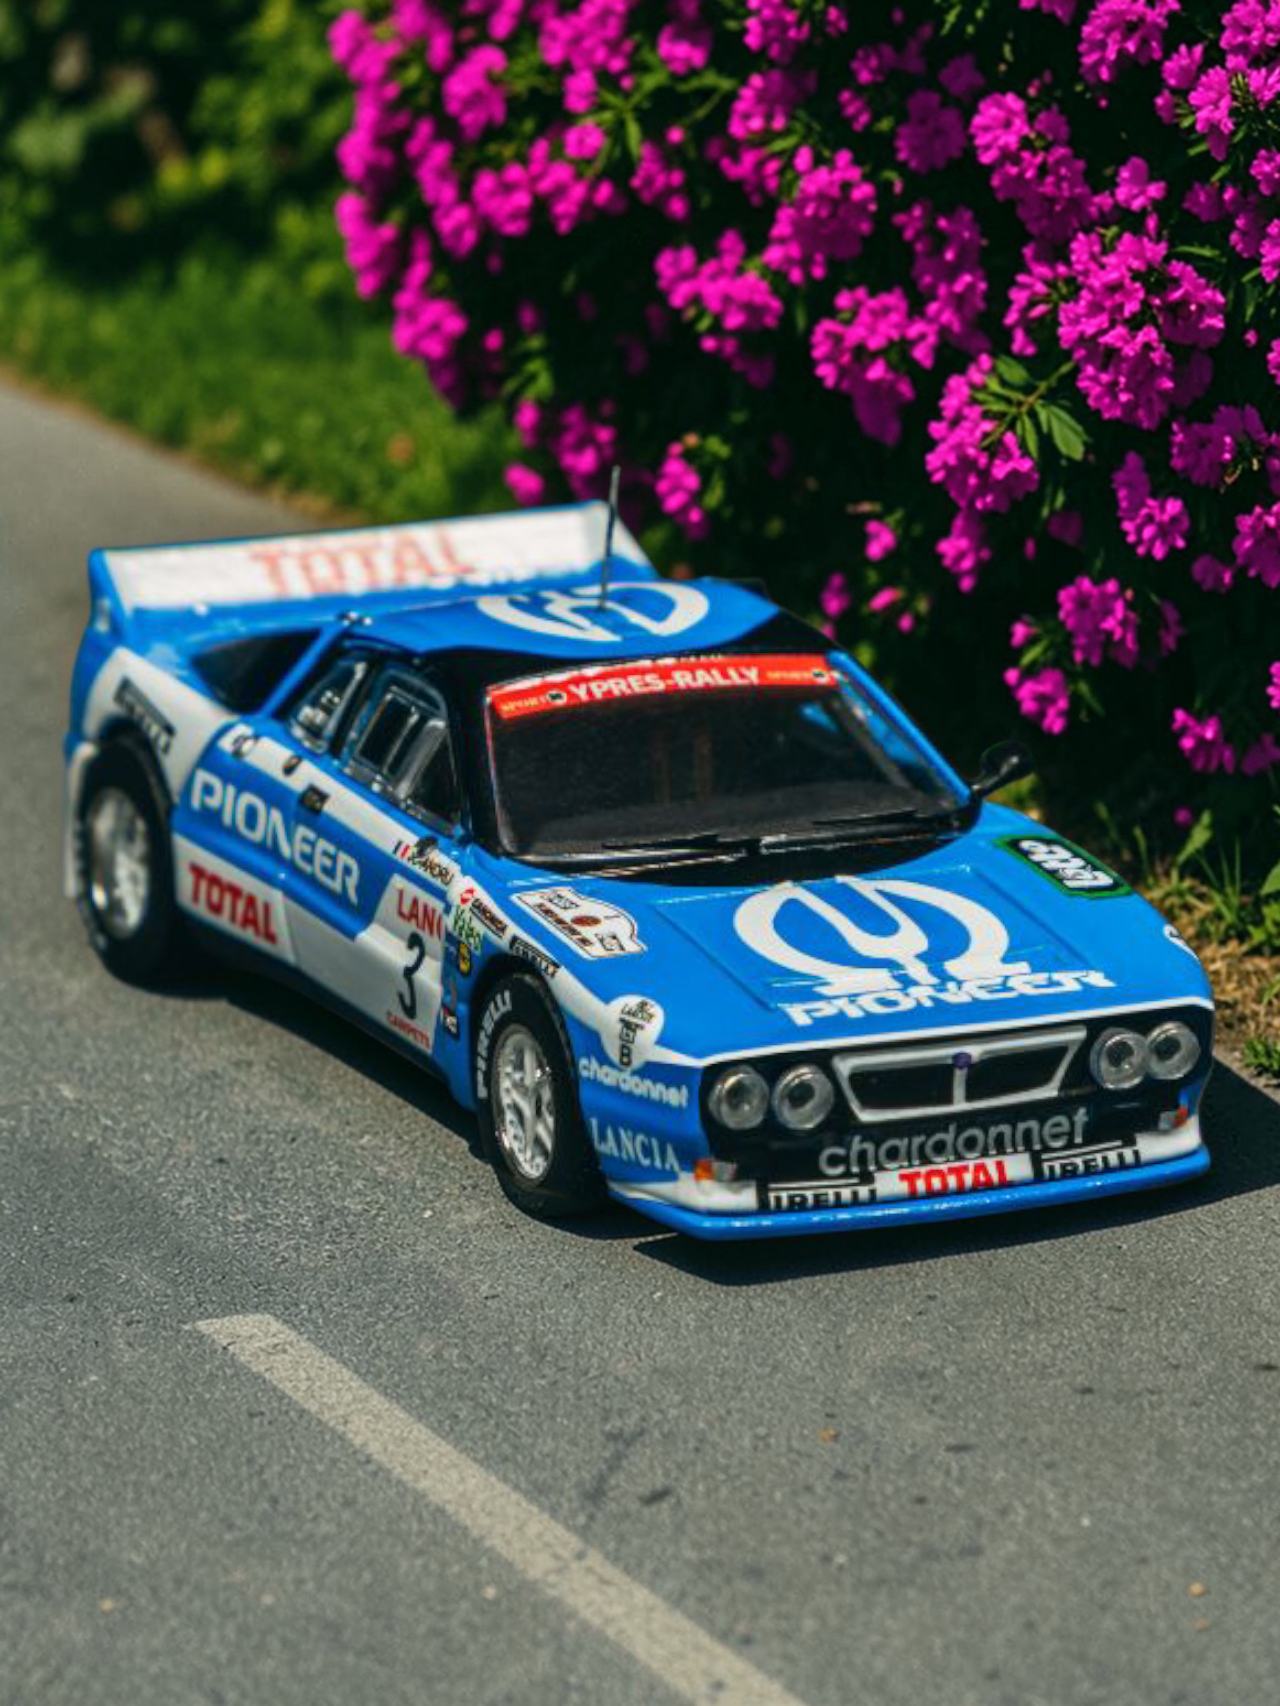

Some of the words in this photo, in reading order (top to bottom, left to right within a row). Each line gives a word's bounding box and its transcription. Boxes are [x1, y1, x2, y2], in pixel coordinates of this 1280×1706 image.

[567, 664, 760, 702] YPRES-RALLY
[190, 768, 361, 905] PIONEER
[189, 861, 278, 945] TOTAL
[398, 931, 426, 1020] 3
[777, 969, 1118, 1028] PIONEER
[578, 1054, 690, 1109] chardonnet
[590, 1117, 681, 1174] LANCIA
[818, 1107, 1089, 1176] chardonnet
[899, 1158, 1010, 1198] TOTAL
